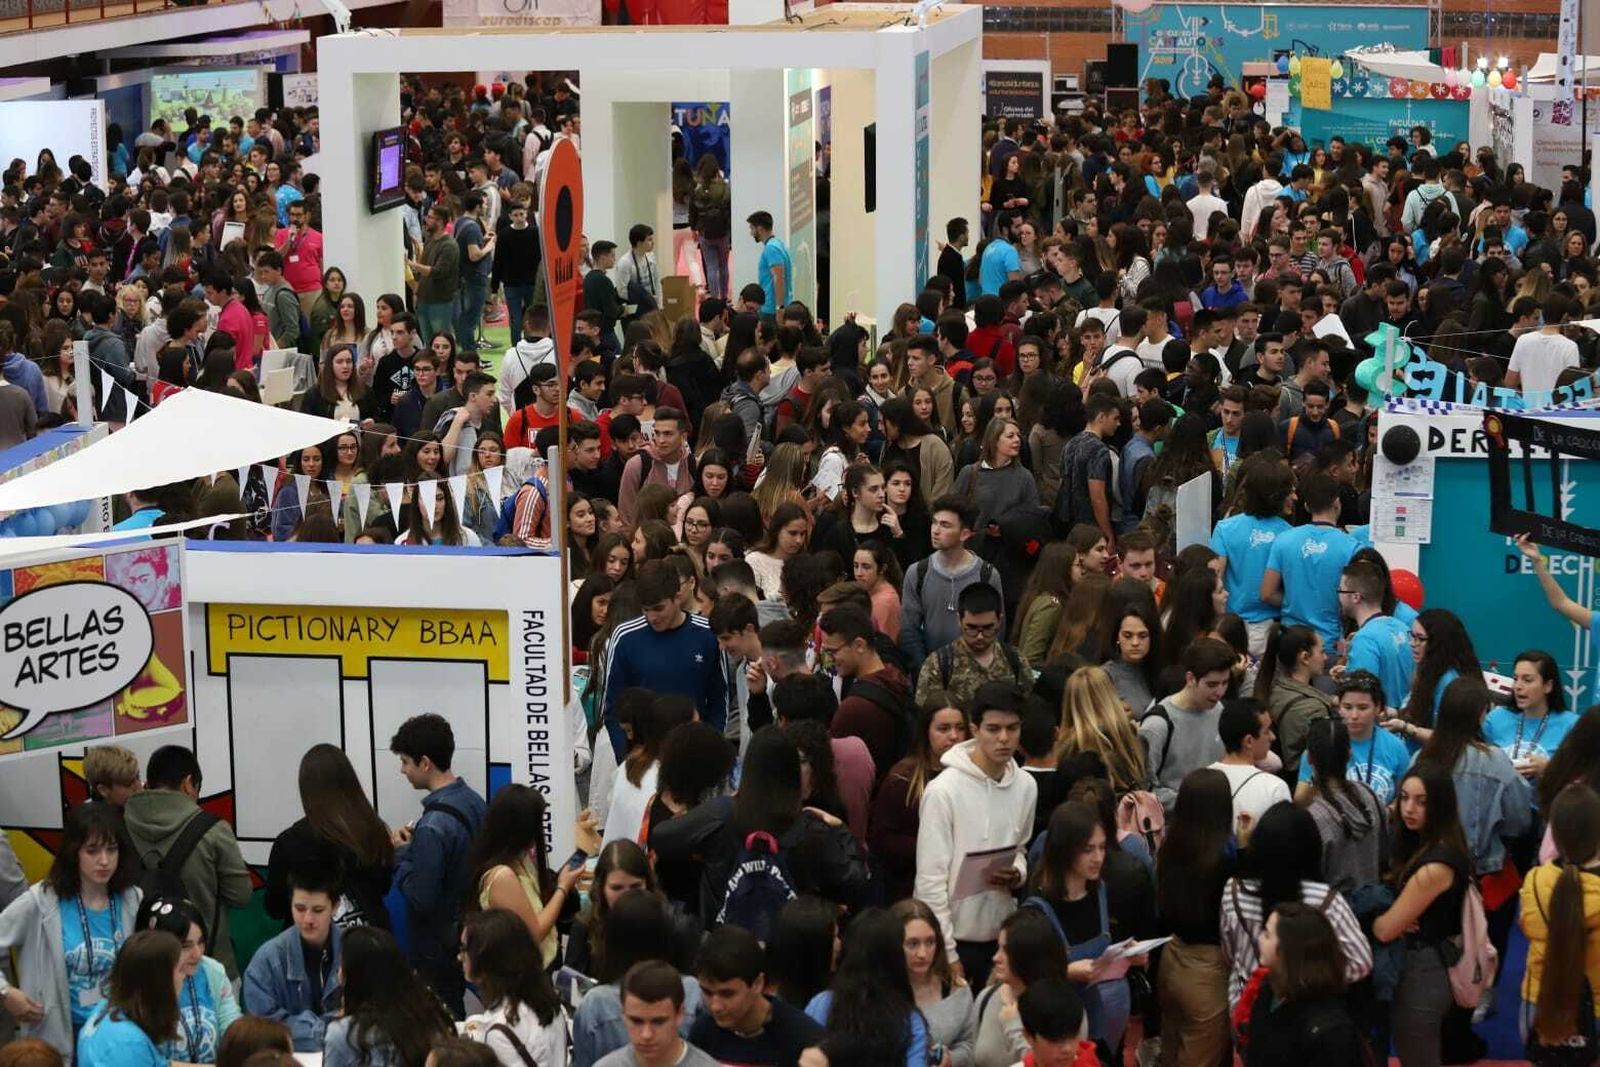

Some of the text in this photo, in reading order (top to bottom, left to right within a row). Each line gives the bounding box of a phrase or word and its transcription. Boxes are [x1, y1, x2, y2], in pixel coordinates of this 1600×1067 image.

[4, 605, 124, 653] BELLAS
[227, 614, 497, 646] PICTIONARY BBAA
[14, 641, 120, 688] ARTES
[522, 610, 548, 698] FACULTAD
[526, 702, 549, 724] DE
[527, 729, 551, 794] BELLAS
